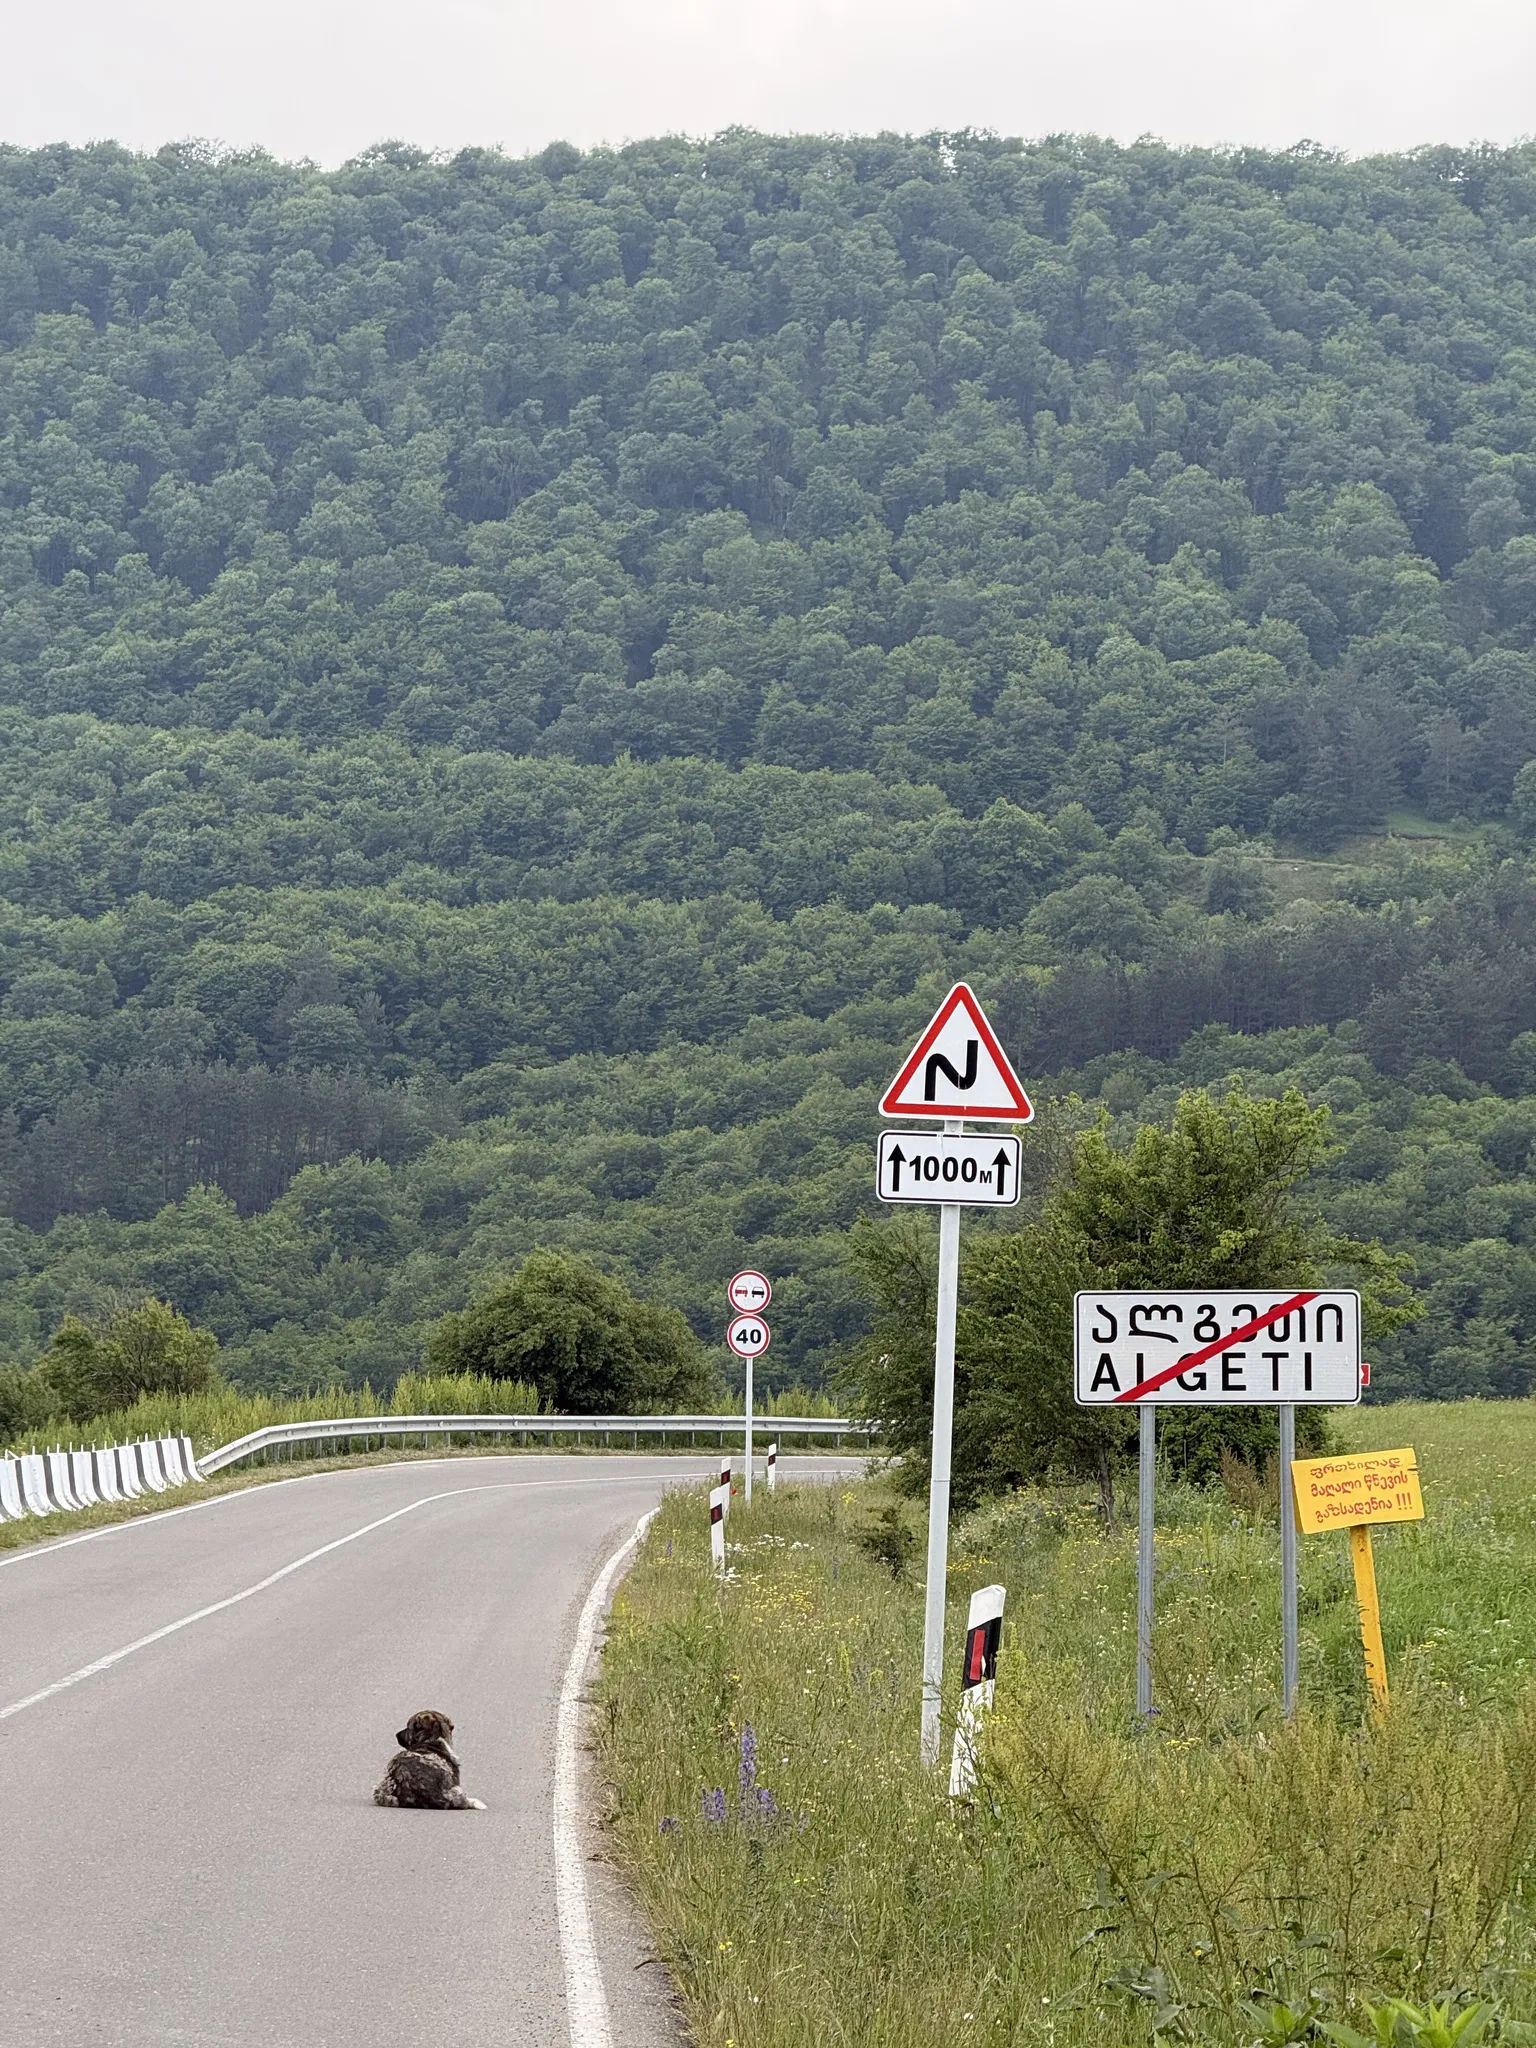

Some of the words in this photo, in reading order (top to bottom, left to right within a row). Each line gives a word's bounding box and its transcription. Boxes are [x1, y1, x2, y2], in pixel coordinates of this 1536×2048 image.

[1091, 1303, 1343, 1343] ალგეთი
[735, 1328, 762, 1344] 40
[1090, 1352, 1313, 1392] ALGETI
[1310, 1479, 1362, 1497] მაღალი
[1396, 1492, 1413, 1510] !!!
